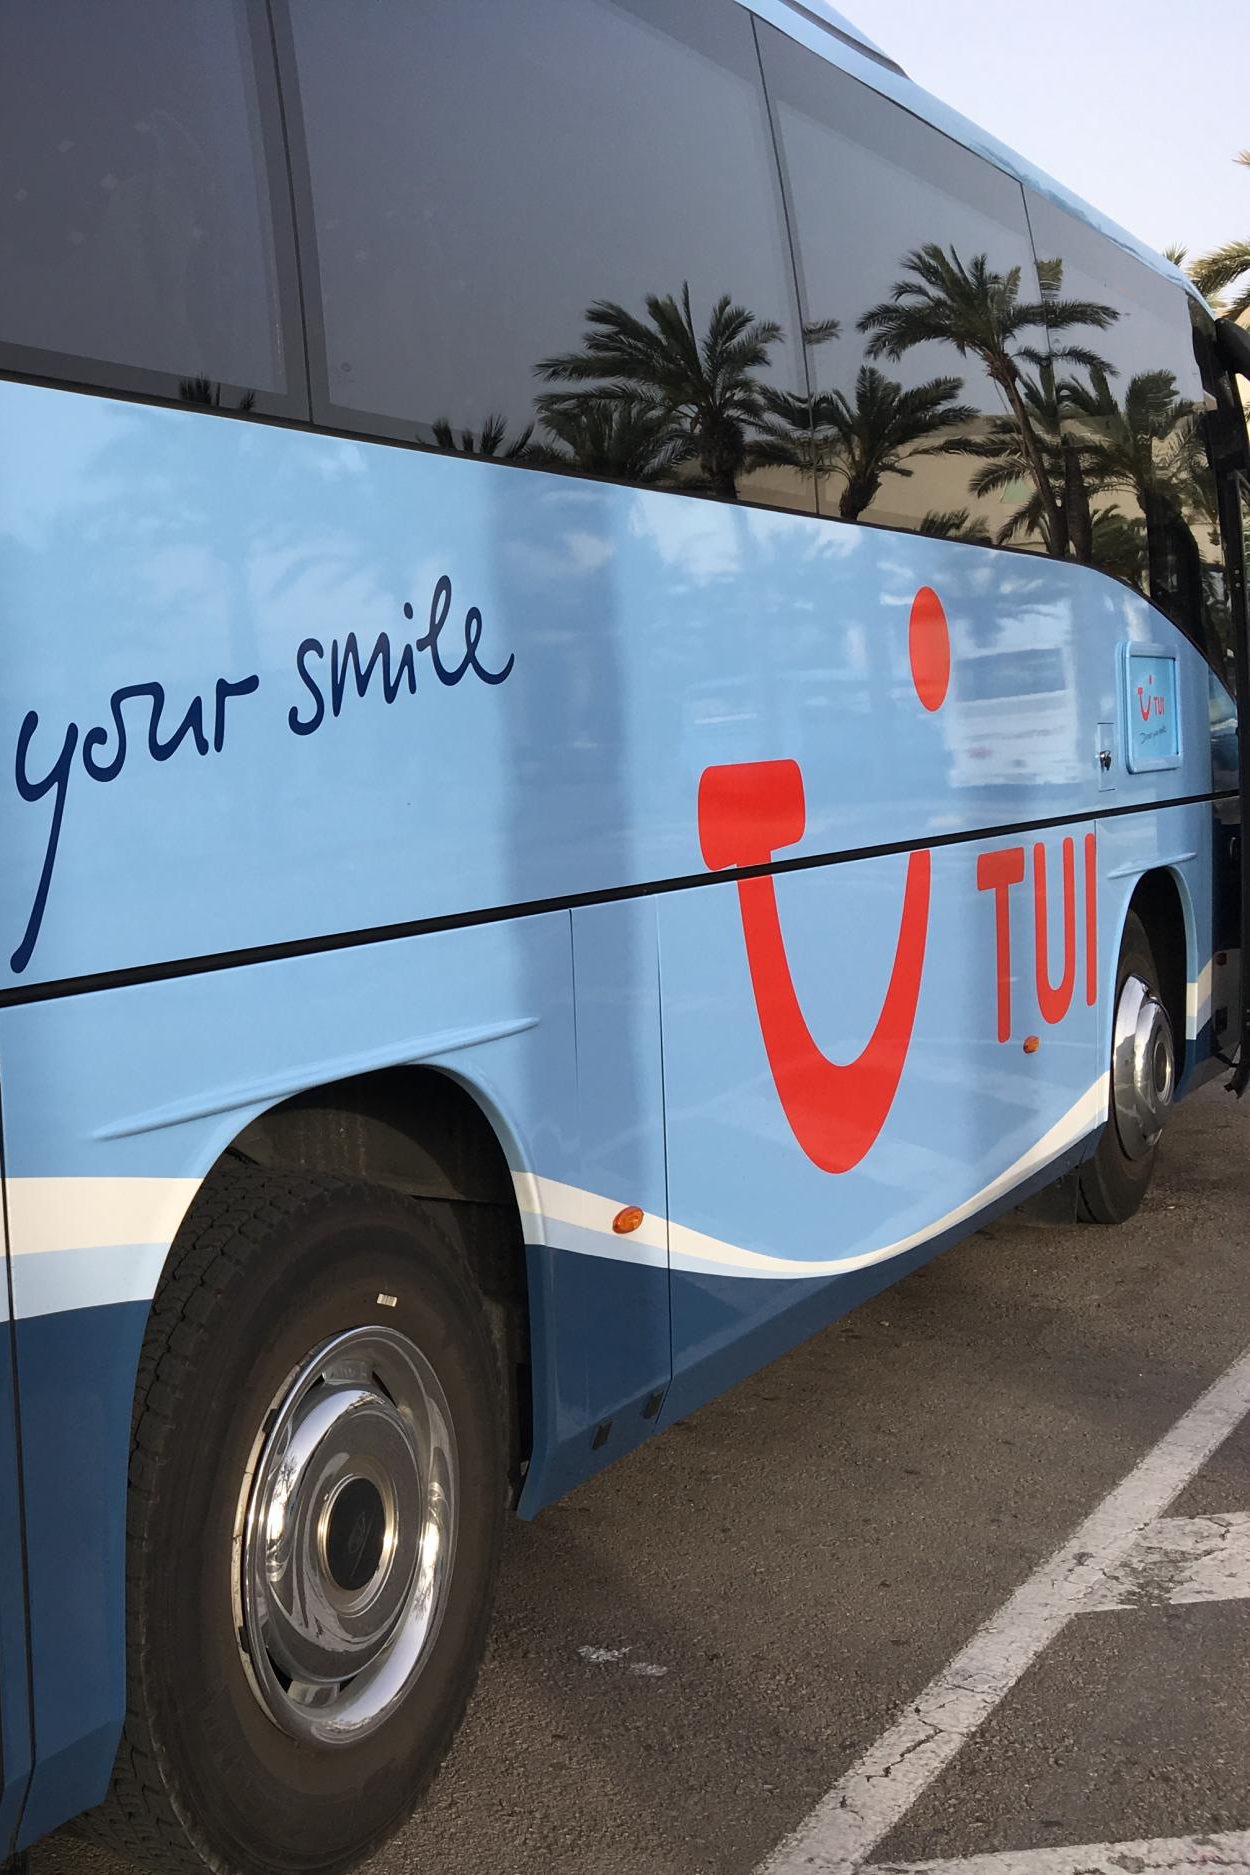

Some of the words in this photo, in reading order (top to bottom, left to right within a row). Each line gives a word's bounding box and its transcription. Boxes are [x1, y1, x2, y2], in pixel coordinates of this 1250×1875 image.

[10, 674, 260, 974] your
[288, 574, 515, 736] smile
[1153, 696, 1165, 716] TUI
[977, 832, 1097, 1044] TUI
